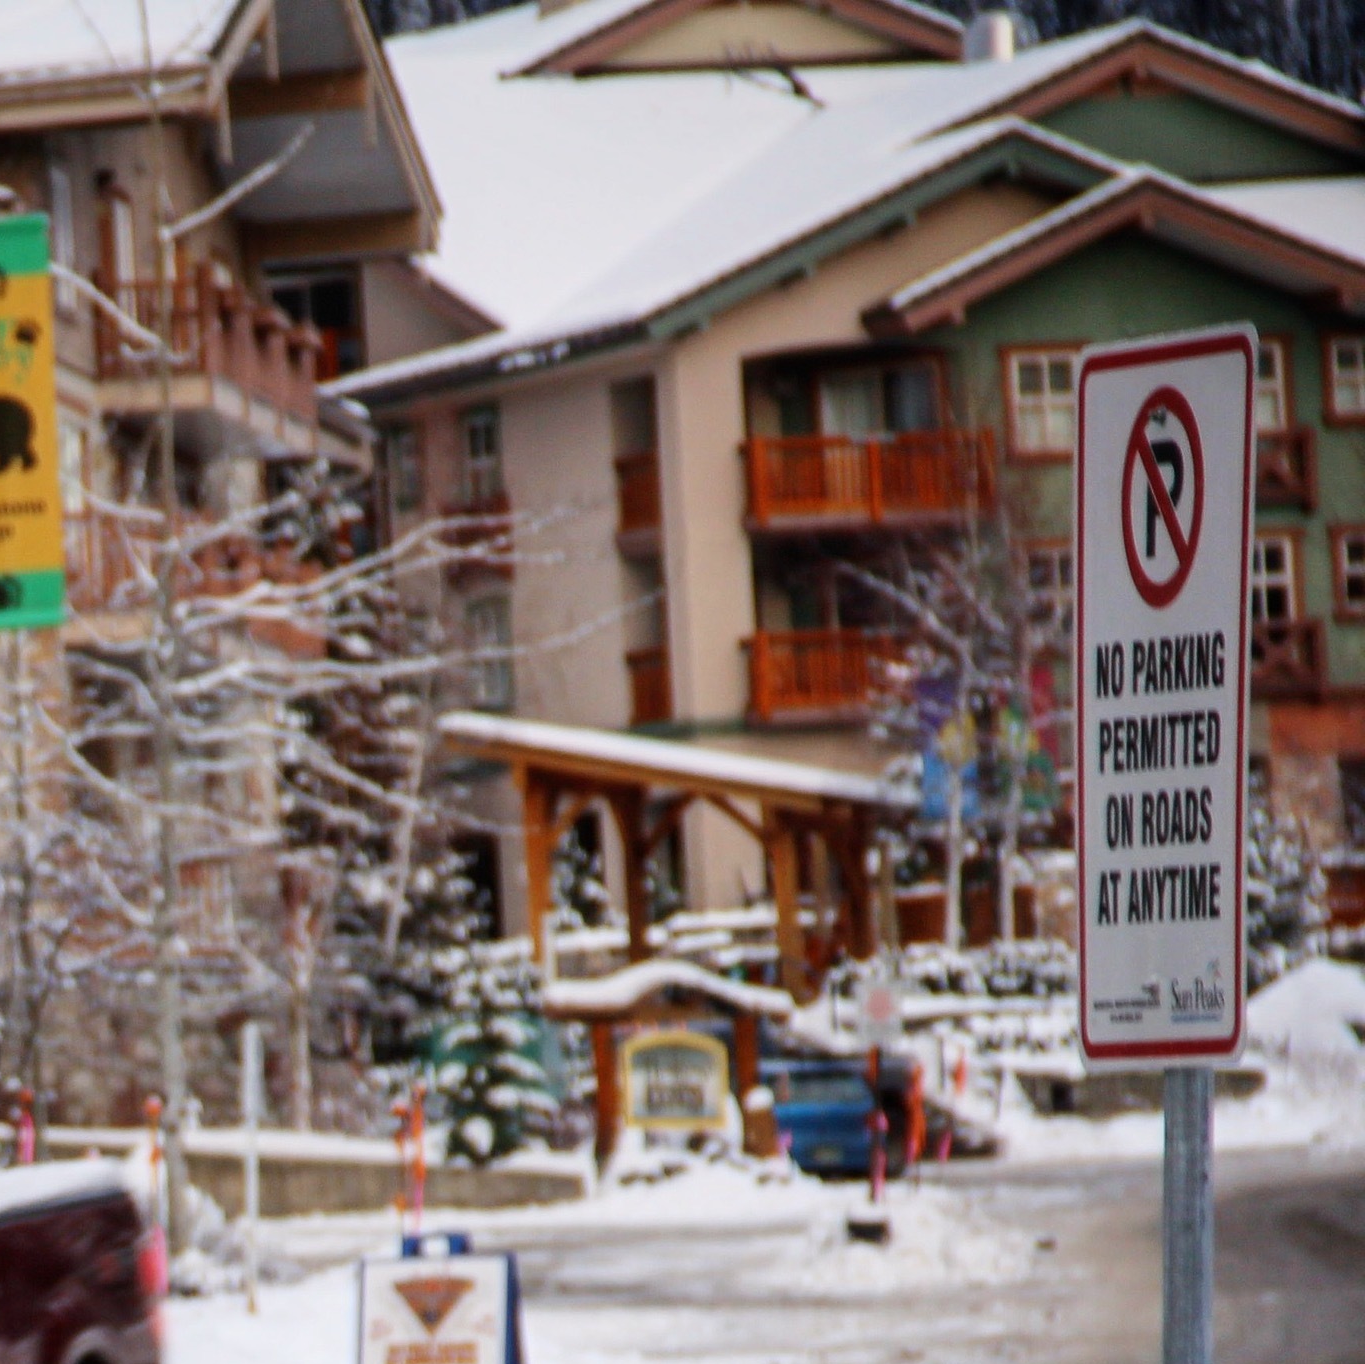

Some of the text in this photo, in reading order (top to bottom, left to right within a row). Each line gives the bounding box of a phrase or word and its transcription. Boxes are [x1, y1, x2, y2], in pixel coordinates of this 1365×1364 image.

[1096, 630, 1226, 698] NO PARKING
[1099, 708, 1221, 776] PERMITTED
[1106, 785, 1213, 850] ON ROADS
[1097, 861, 1222, 926] AT ANYTIME
